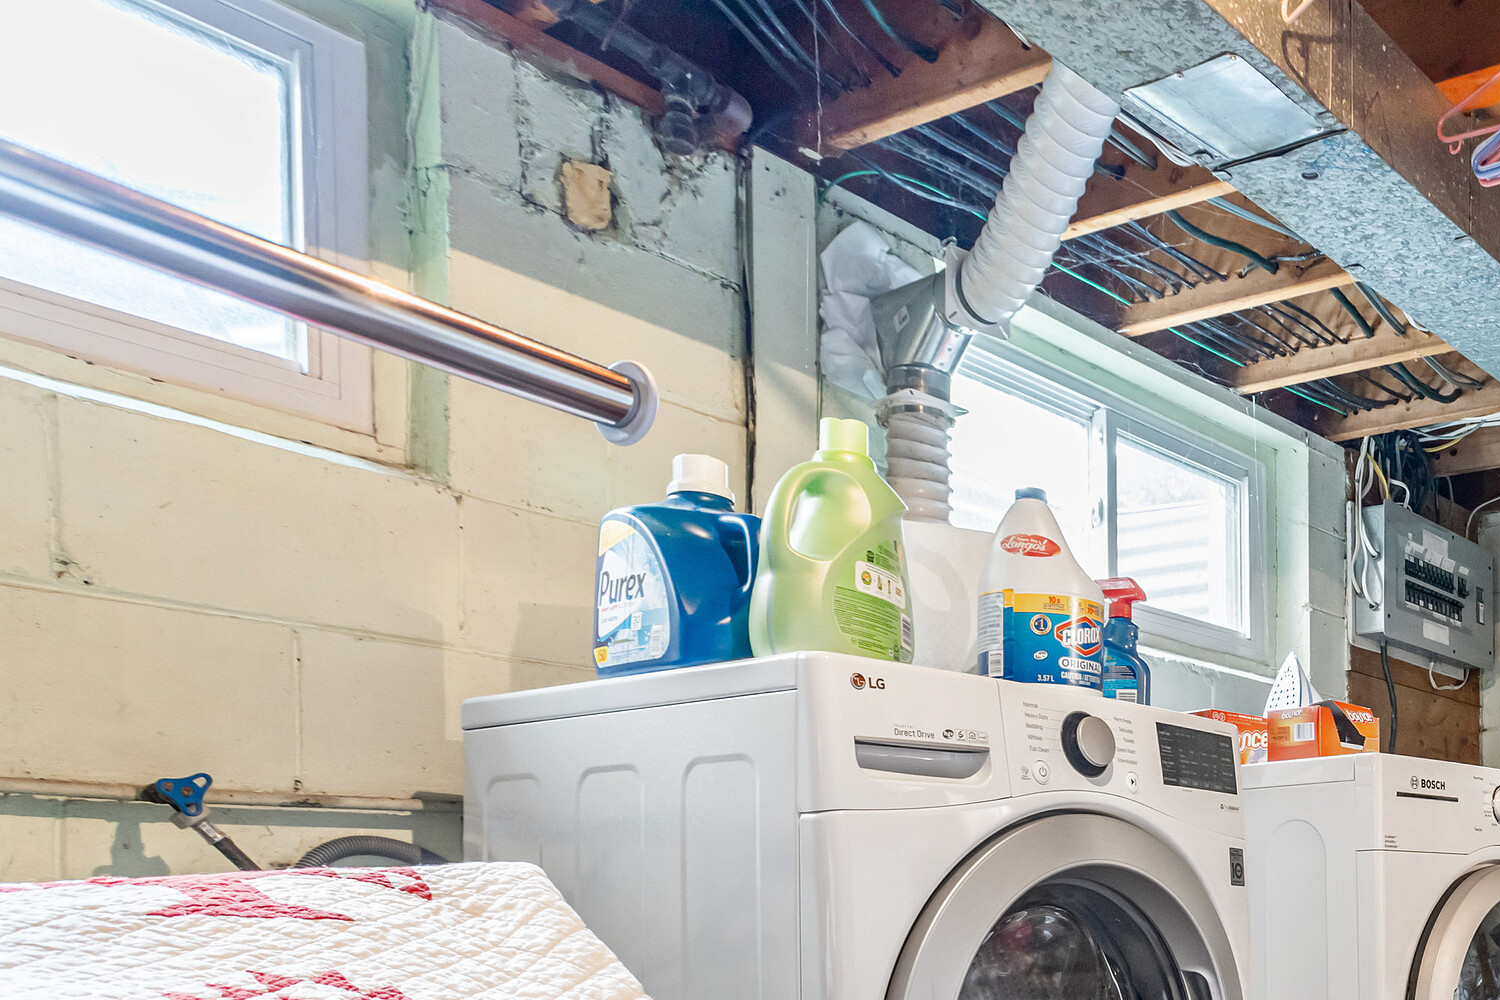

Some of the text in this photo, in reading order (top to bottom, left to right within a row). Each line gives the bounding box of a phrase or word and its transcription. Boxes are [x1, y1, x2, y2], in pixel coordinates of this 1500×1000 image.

[600, 571, 647, 607] Purex
[1062, 627, 1101, 646] CLOROX
[1061, 658, 1101, 673] ORIGINAL
[868, 677, 886, 690] LG
[1037, 674, 1050, 682] 3.57
[1345, 708, 1374, 724] bounce
[893, 727, 935, 739] Direct Drive
[1420, 778, 1446, 791] BOSCH
